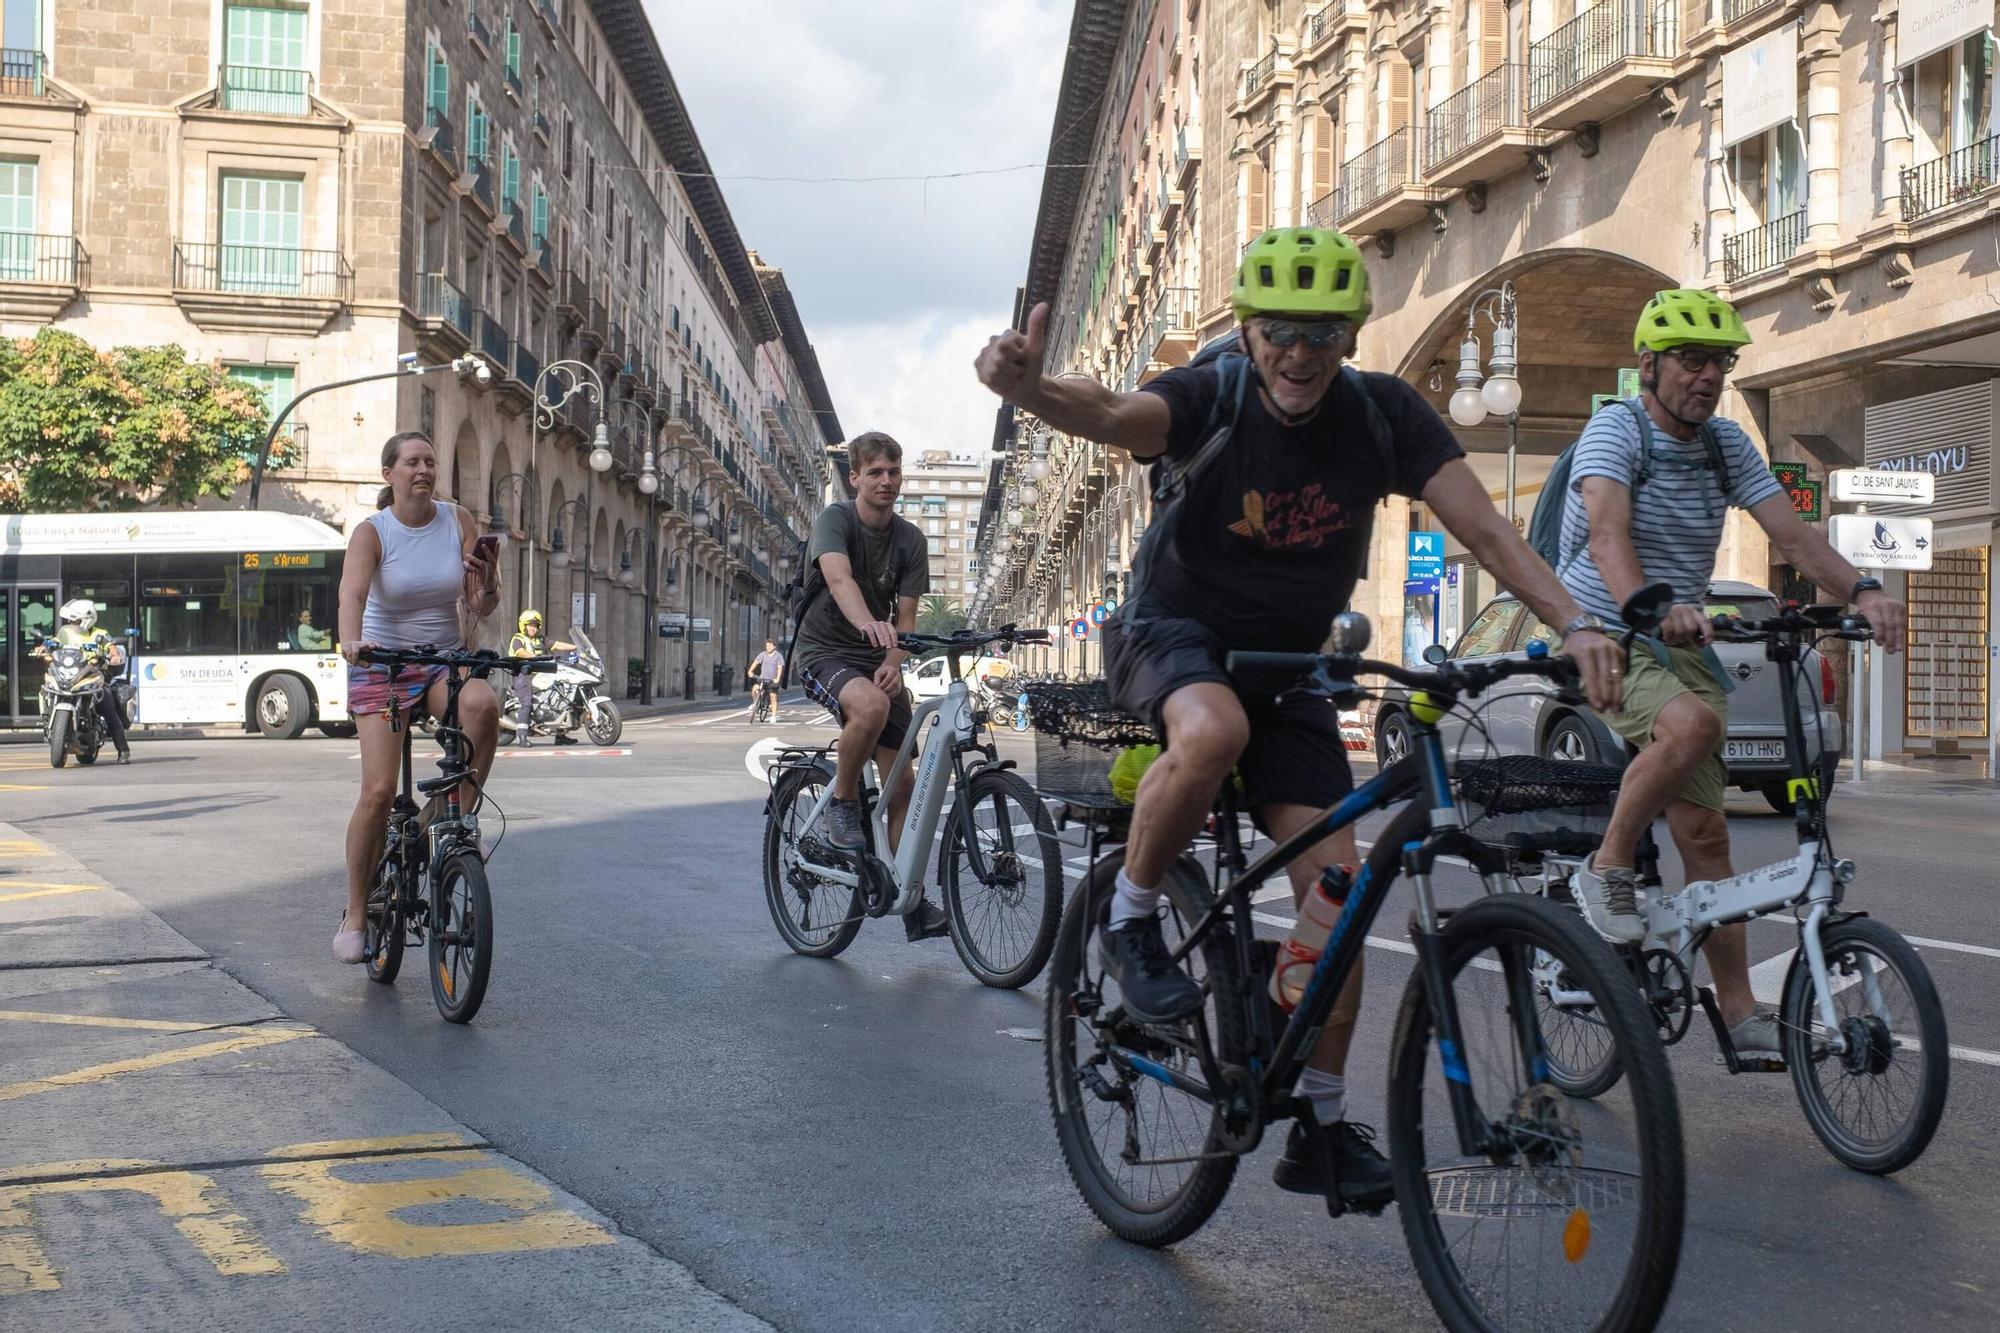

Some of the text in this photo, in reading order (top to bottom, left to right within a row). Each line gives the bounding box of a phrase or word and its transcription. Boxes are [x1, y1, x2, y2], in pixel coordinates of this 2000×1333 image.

[1864, 476, 1874, 487] DE
[1875, 476, 1893, 488] SANT
[1895, 477, 1920, 490] JAUME
[79, 525, 121, 535] Natural
[244, 552, 310, 569] 25 s'Arenal
[180, 669, 234, 678] SIN DEUDA
[1758, 742, 1782, 757] HNG
